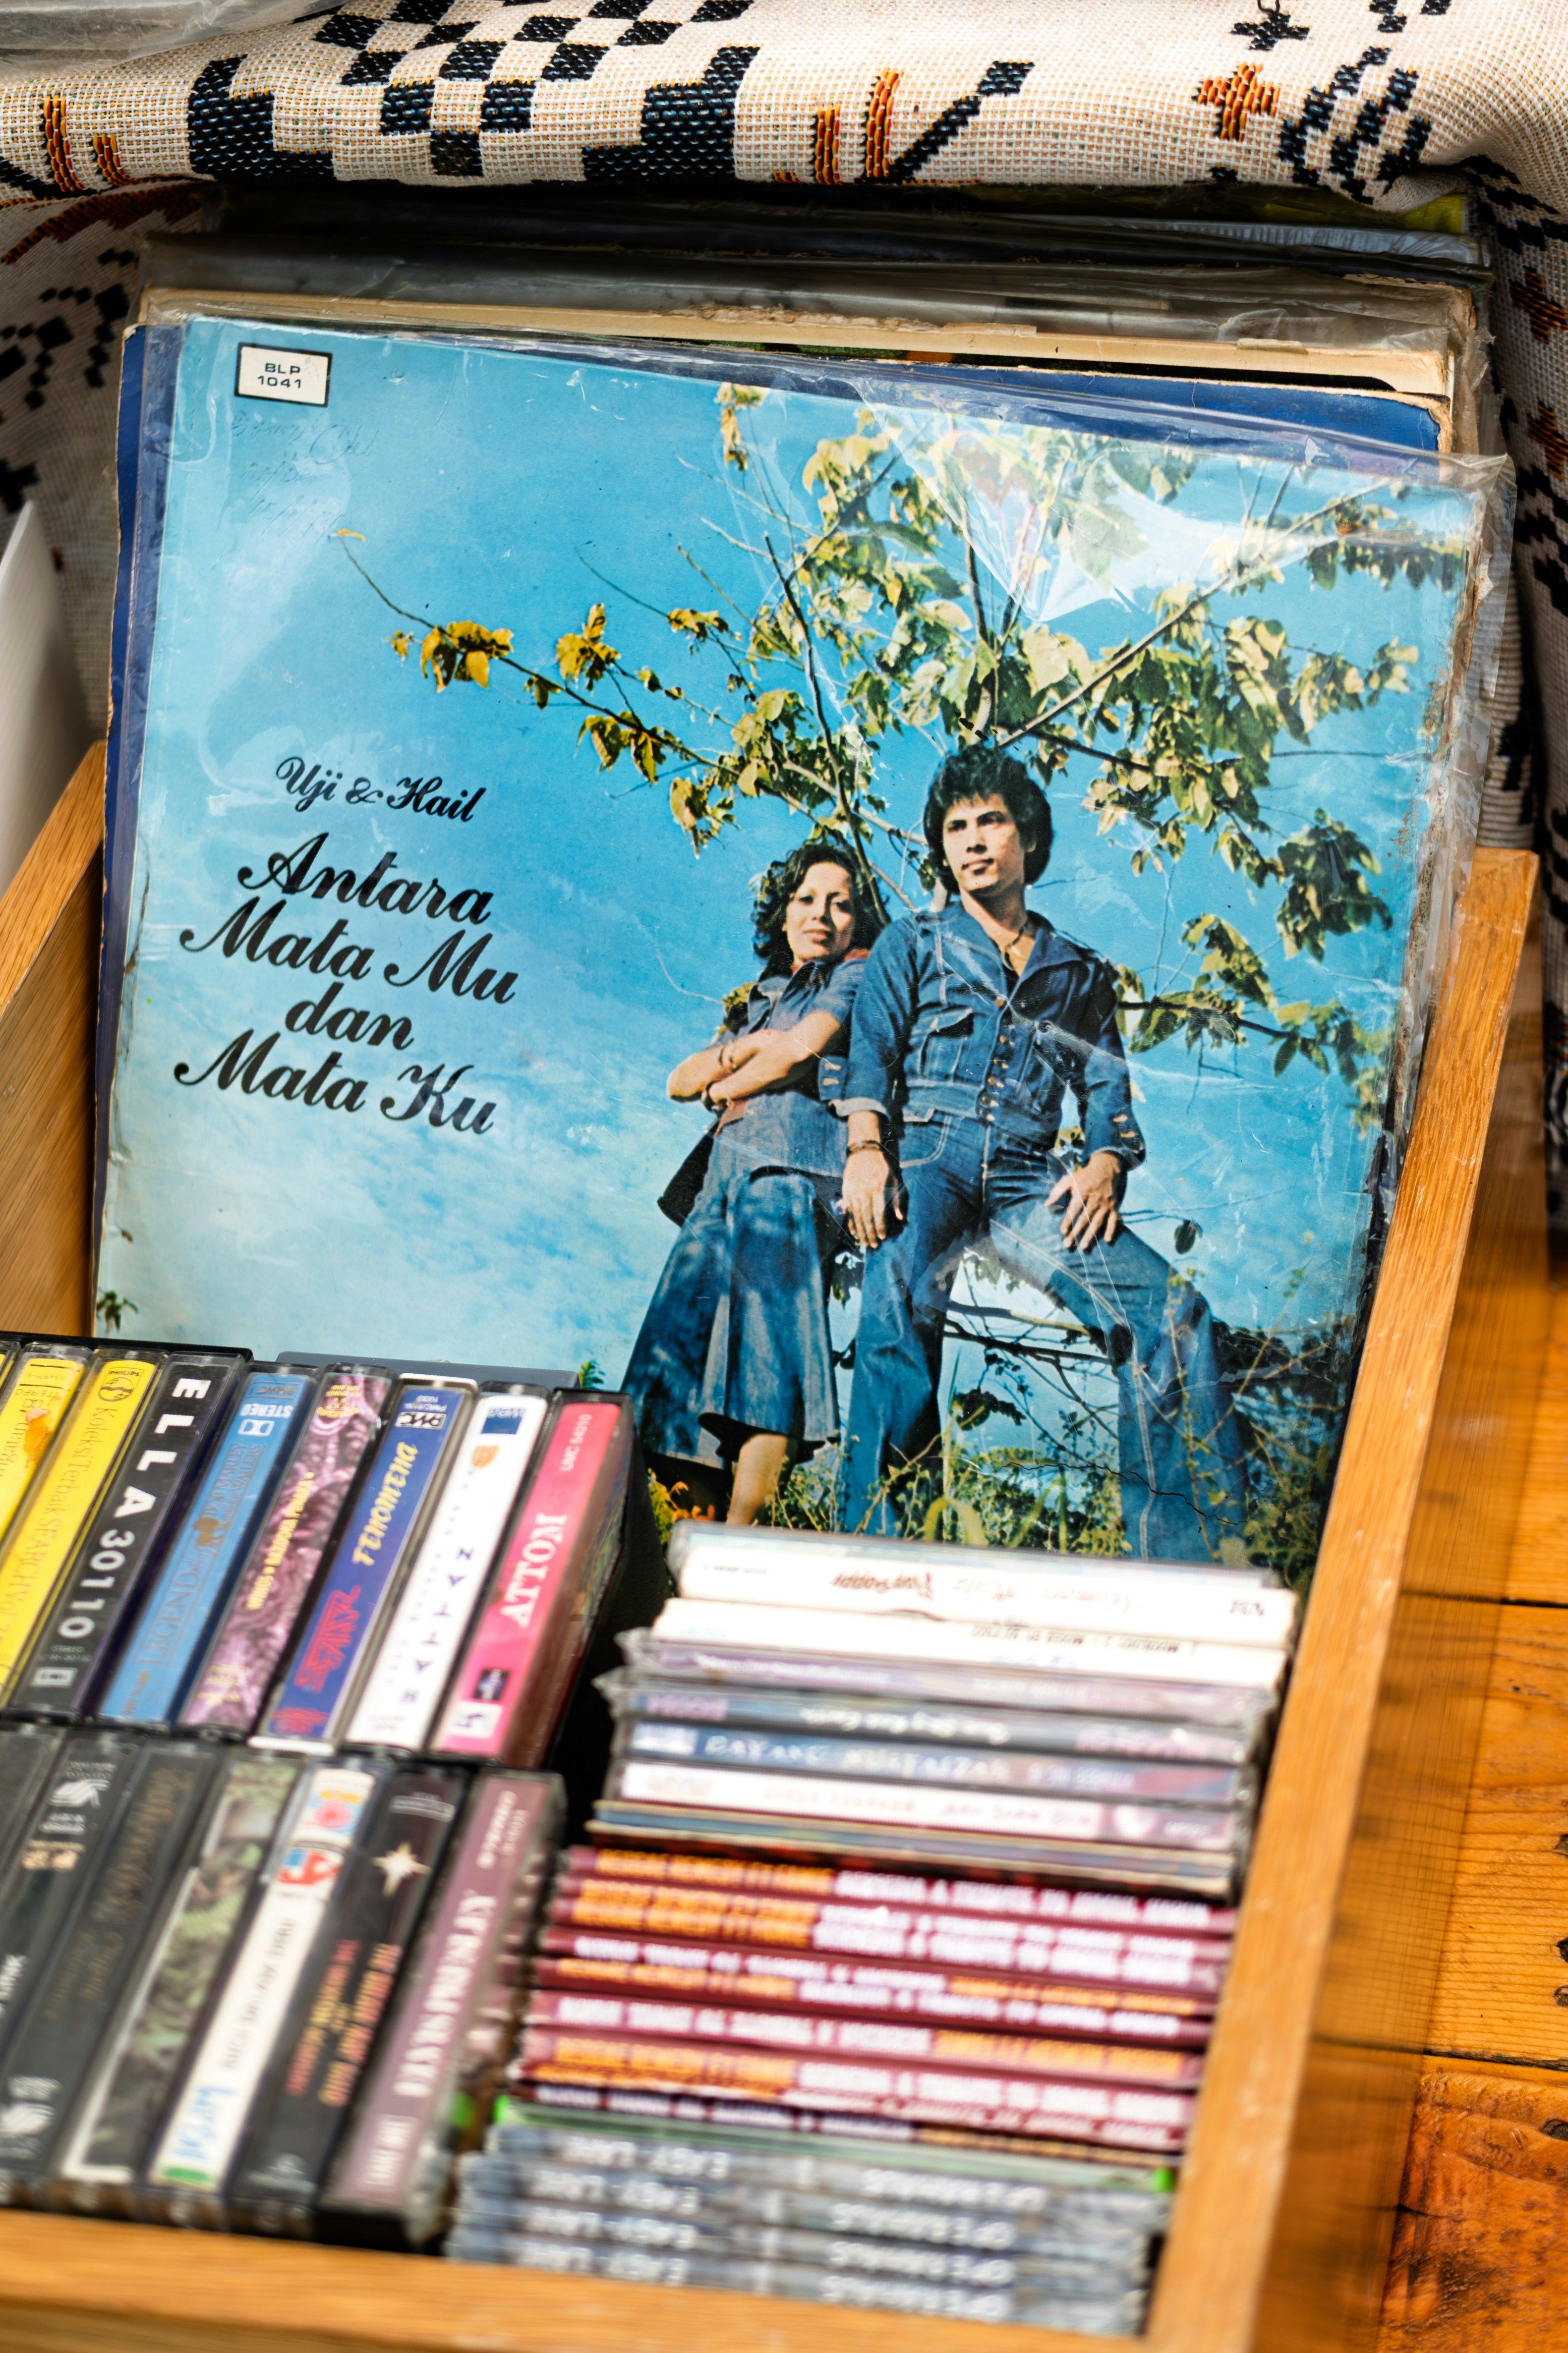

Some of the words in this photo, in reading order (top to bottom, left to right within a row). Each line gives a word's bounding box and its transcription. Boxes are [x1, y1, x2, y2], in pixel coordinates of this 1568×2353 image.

[257, 375, 302, 389] 1041
[265, 362, 301, 375] BLP
[276, 756, 343, 812] Uji
[345, 777, 384, 804] &
[387, 776, 486, 822] Hail
[238, 832, 495, 925] Antara
[180, 895, 375, 980] Mata
[384, 929, 519, 1004] Mu
[284, 981, 415, 1050] dan
[173, 1028, 370, 1112] Mata
[380, 1063, 497, 1135] Ku
[15, 1388, 64, 1400] STEREO
[108, 1369, 141, 1379] PHILIPS
[73, 1408, 118, 1459] Koleksi
[239, 1403, 294, 1419] STEREO
[399, 1412, 443, 1428] PMC
[568, 1414, 593, 1444] 54010
[114, 1377, 212, 1519] ELLA
[212, 1442, 249, 1491] MARLEY
[229, 1443, 264, 1491] WAILERS
[558, 1445, 582, 1472] UMC
[44, 1463, 91, 1516] Terbaik
[351, 1440, 419, 1566] FENOMENA
[9, 1518, 63, 1588] SEARCH
[499, 1511, 568, 1629] ATTOM
[57, 1529, 136, 1639] 30110
[245, 1574, 275, 1610] WINGS
[140, 1570, 202, 1665] LEGEND
